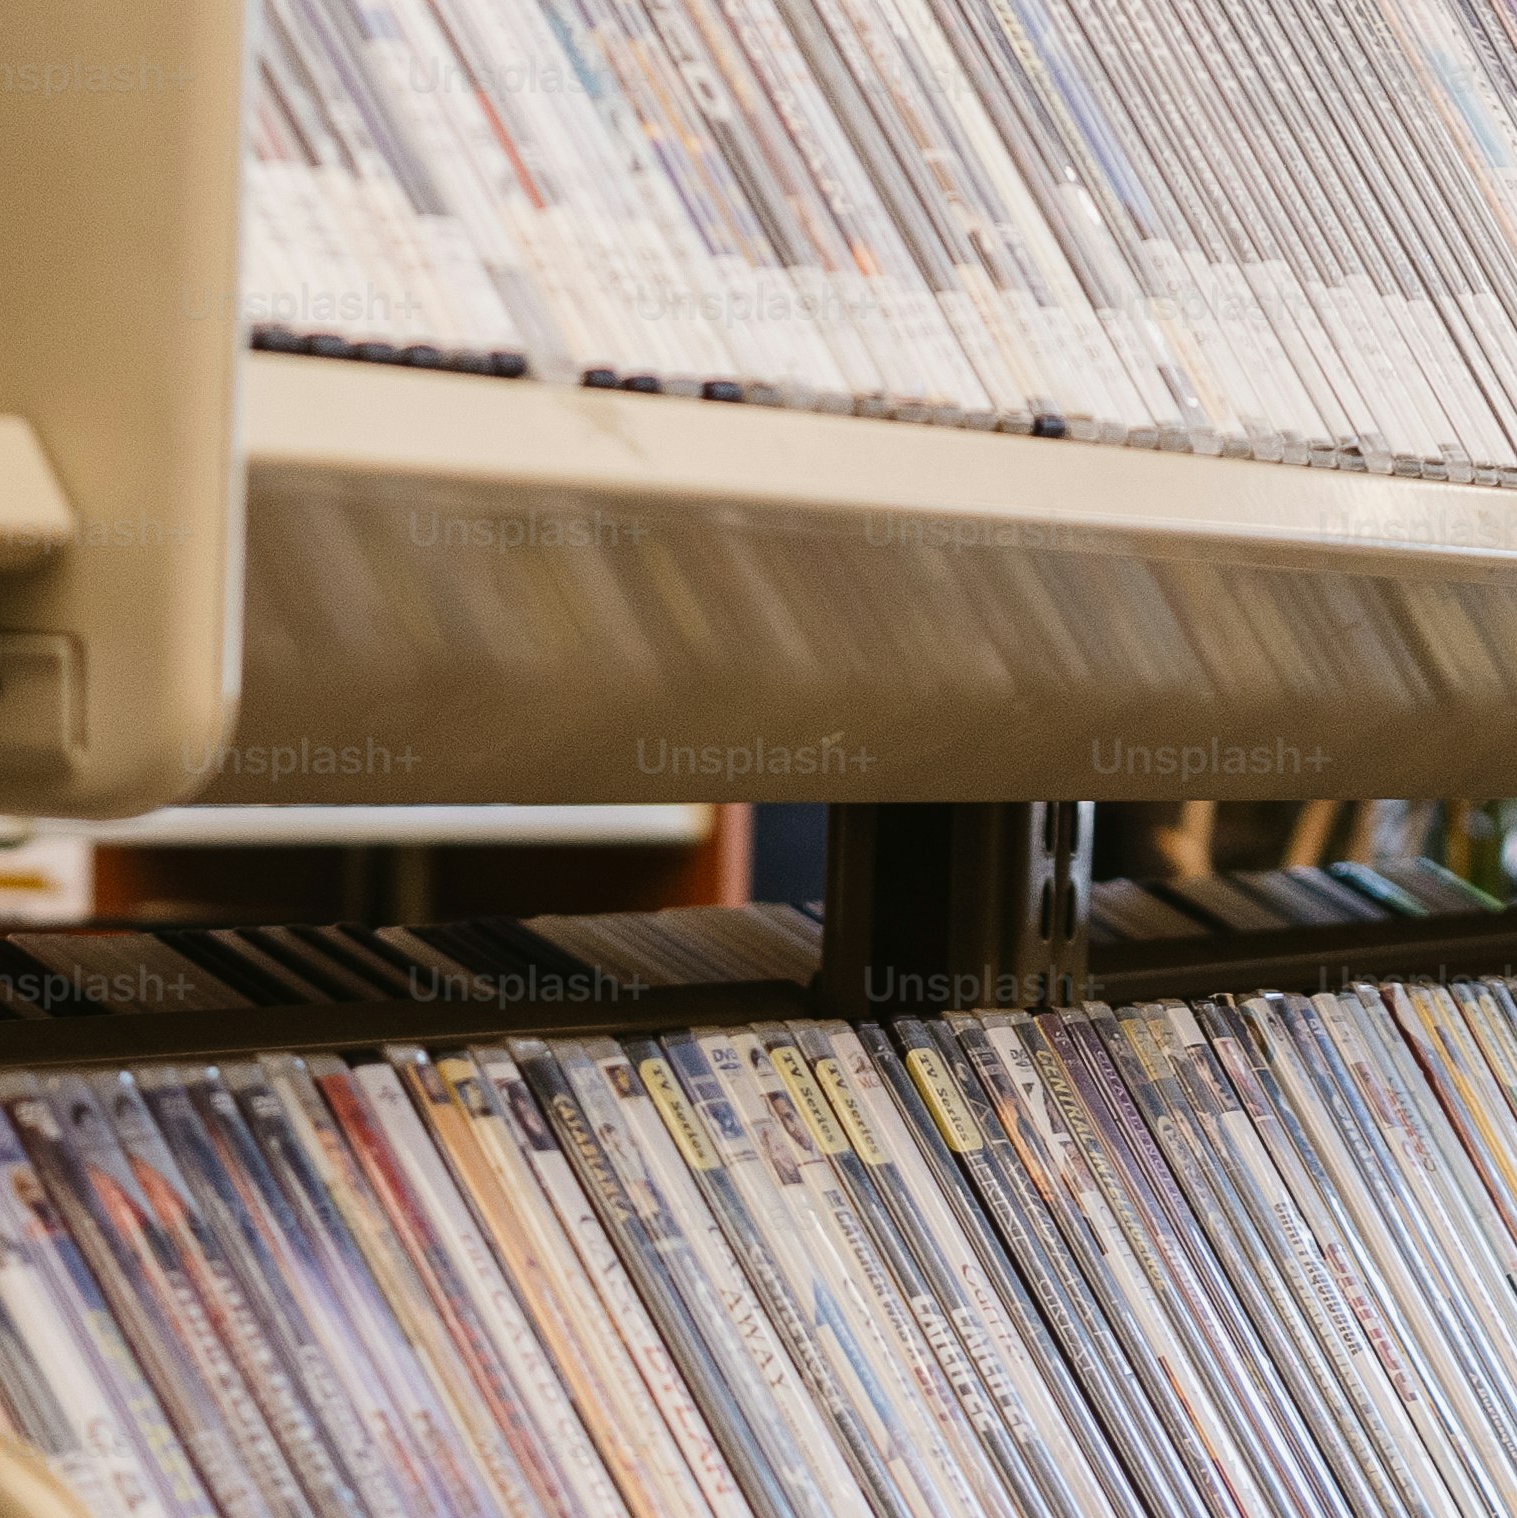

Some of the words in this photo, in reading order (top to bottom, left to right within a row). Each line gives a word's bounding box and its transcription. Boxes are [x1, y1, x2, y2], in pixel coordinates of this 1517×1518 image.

[650, 1063, 674, 1096] TV
[668, 1097, 708, 1160] Series
[780, 1050, 802, 1078] TV
[798, 1084, 840, 1146] Series
[824, 1061, 848, 1092] TV
[842, 1095, 883, 1157] Series
[917, 1052, 939, 1082] TV
[934, 1085, 972, 1144] Series
[549, 1088, 635, 1227] CASABLANCA
[1032, 1046, 1096, 1147] CENTRAL
[1086, 1147, 1173, 1293] INTELLIGENCE
[832, 1205, 891, 1298] CATCHER
[719, 1280, 791, 1396] AWAY
[958, 1258, 1028, 1366] Carrie
